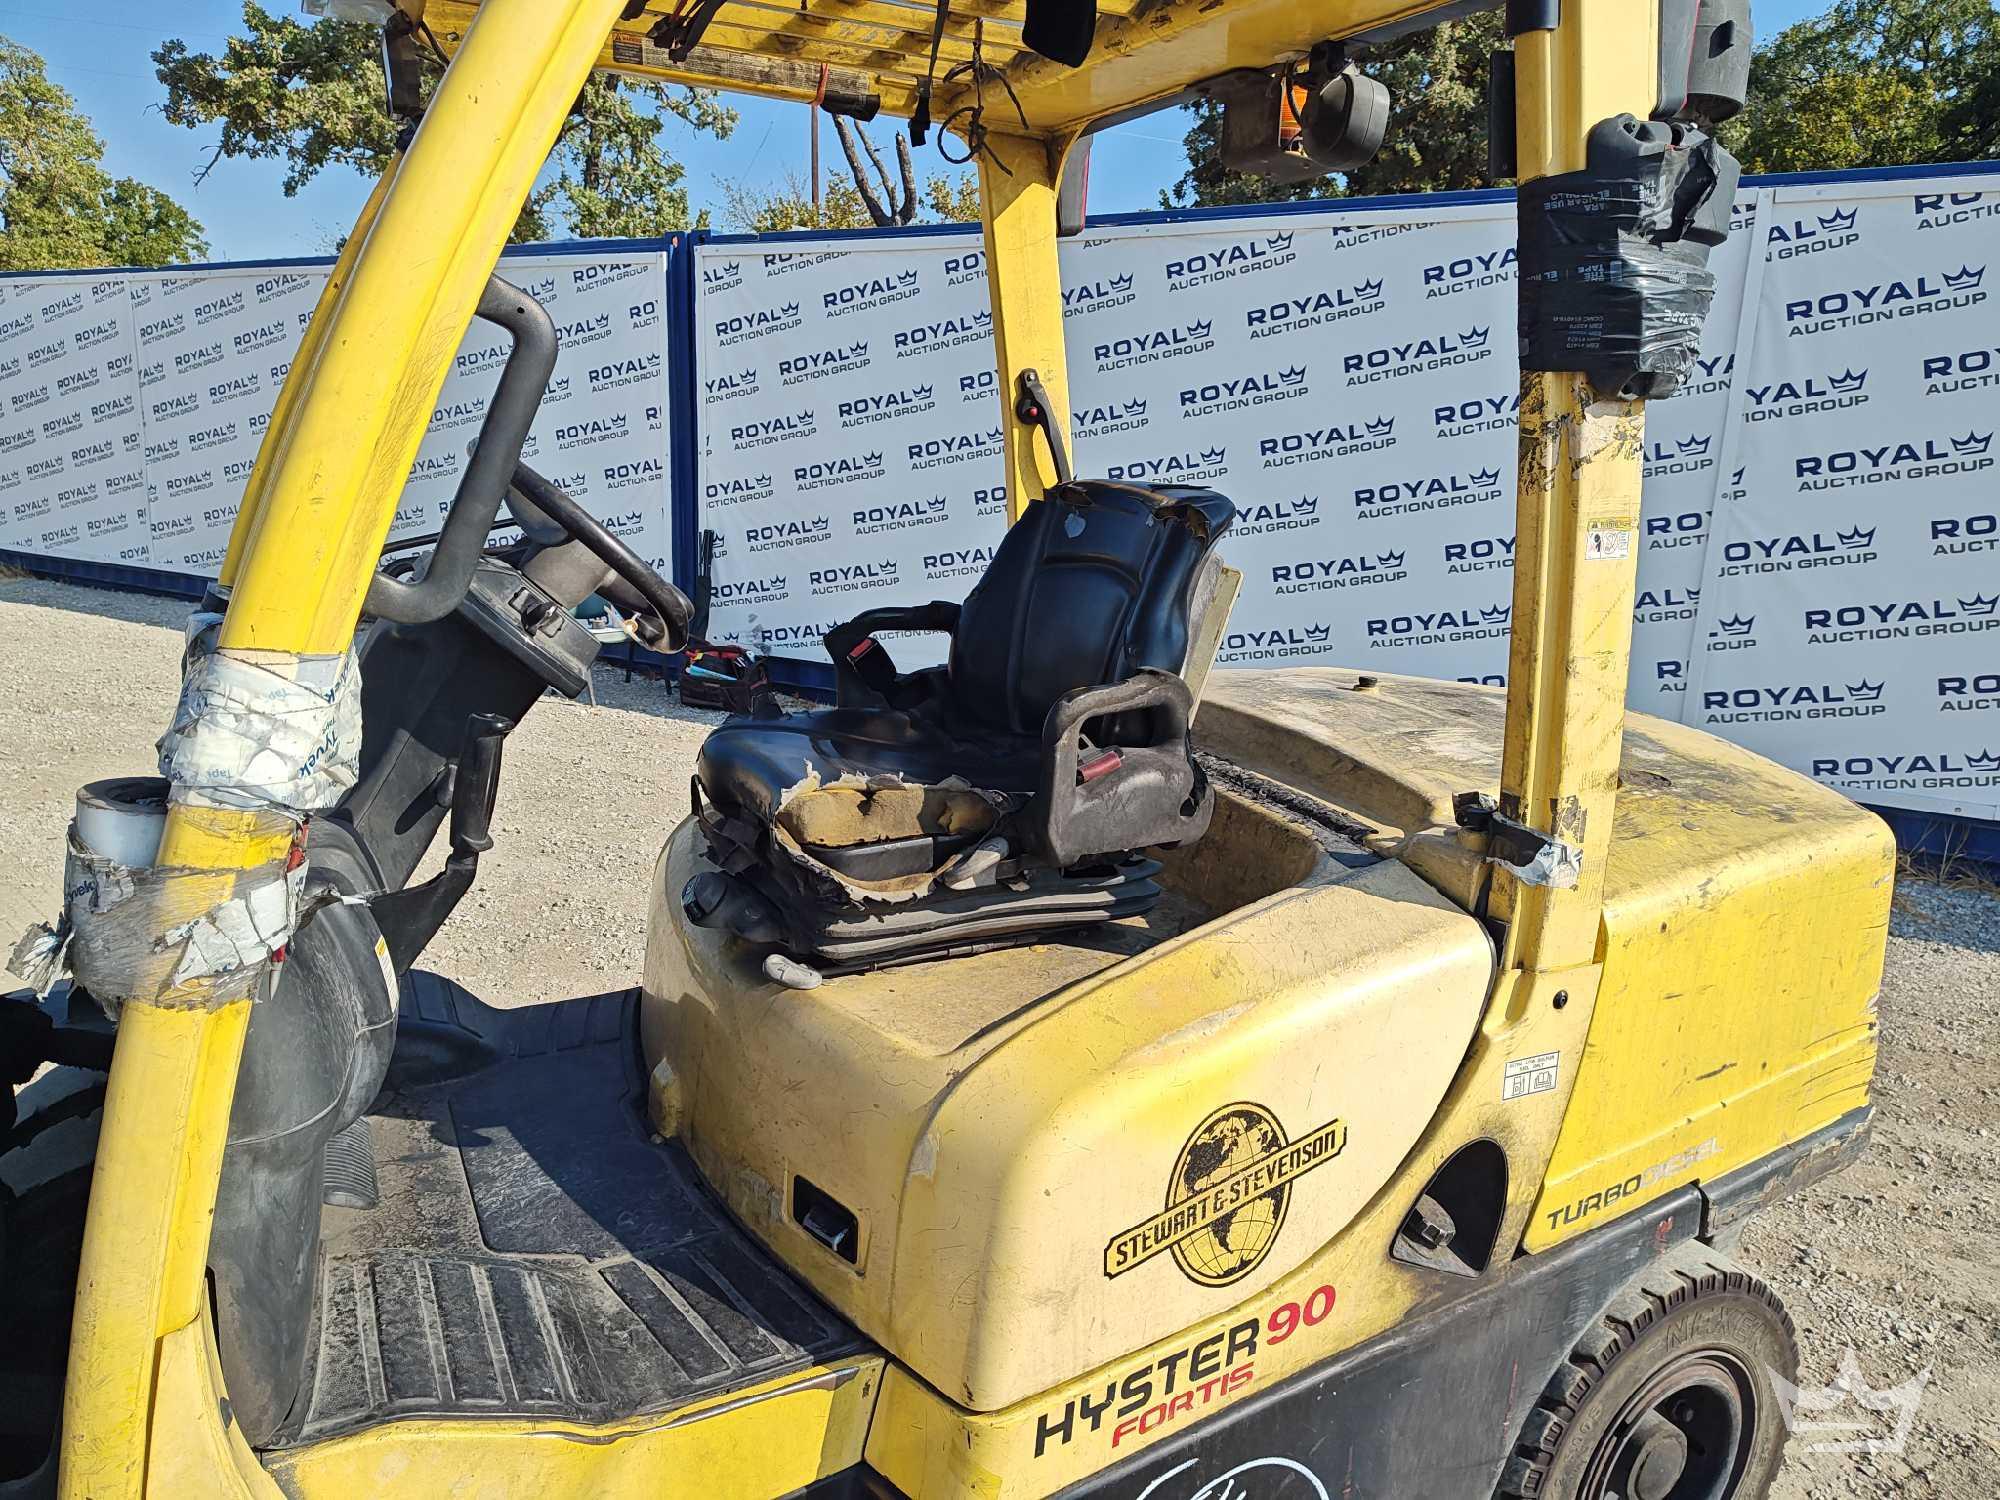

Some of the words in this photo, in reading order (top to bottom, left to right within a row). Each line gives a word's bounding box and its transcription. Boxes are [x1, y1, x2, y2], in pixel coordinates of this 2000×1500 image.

[1780, 233, 1859, 260] GROUP
[768, 259, 813, 277] AUCTION
[1166, 242, 1266, 279] ROYAL
[576, 276, 613, 293] AUCTION
[617, 266, 648, 281] GROUP
[1169, 268, 1235, 292] AUCTION
[1240, 252, 1295, 274] GROUP
[256, 274, 298, 295] ROYAL
[708, 279, 742, 294] GROUP
[823, 277, 897, 308] ROYAL
[1426, 271, 1508, 299] AUCTION
[42, 297, 73, 317] ROYAL
[194, 297, 233, 318] ROYAL
[827, 300, 876, 320] AUCTION
[879, 286, 919, 306] GROUP
[1087, 293, 1135, 314] GROUP
[1247, 289, 1354, 327] ROYAL
[1786, 277, 1941, 321] ROYAL
[715, 309, 782, 337] ROYAL
[1250, 316, 1320, 339] AUCTION
[1325, 300, 1384, 322] GROUP
[1789, 309, 1892, 338] AUCTION
[1899, 291, 1986, 318] GROUP
[75, 323, 109, 344] ROYAL
[139, 318, 174, 338] ROYAL
[234, 326, 274, 347] ROYAL
[582, 330, 612, 345] GROUP
[720, 329, 762, 347] AUCTION
[765, 317, 801, 334] GROUP
[894, 317, 973, 348] ROYAL
[28, 344, 58, 362] ROYAL
[897, 340, 948, 360] AUCTION
[1094, 328, 1187, 361] ROYAL
[1098, 352, 1158, 372] AUCTION
[1162, 339, 1213, 359] GROUP
[1344, 336, 1458, 374] ROYAL
[175, 347, 212, 367] ROYAL
[456, 345, 508, 368] ROYAL
[779, 348, 850, 376] ROYAL
[1347, 363, 1422, 387] AUCTION
[1427, 348, 1490, 370] GROUP
[57, 371, 89, 390] ROYAL
[459, 363, 493, 377] AUCTION
[588, 358, 647, 383] ROYAL
[782, 369, 828, 386] AUCTION
[831, 357, 869, 374] GROUP
[209, 378, 248, 397] ROYAL
[592, 377, 630, 393] AUCTION
[726, 386, 759, 399] GROUP
[1180, 374, 1278, 406] ROYAL
[11, 388, 41, 406] ROYAL
[91, 398, 125, 417] ROYAL
[153, 396, 189, 415] ROYAL
[838, 391, 913, 418] ROYAL
[1183, 398, 1248, 418] AUCTION
[1253, 386, 1307, 405] GROUP
[1789, 395, 1869, 416] GROUP
[43, 416, 73, 433] ROYAL
[842, 411, 891, 428] AUCTION
[894, 400, 934, 417] GROUP
[189, 426, 227, 444] ROYAL
[555, 419, 612, 441] ROYAL
[731, 416, 798, 440] ROYAL
[1102, 417, 1148, 435] GROUP
[1437, 416, 1519, 438] AUCTION
[559, 437, 596, 449] AUCTION
[598, 429, 628, 441] GROUP
[734, 436, 778, 450] AUCTION
[780, 427, 816, 441] GROUP
[908, 433, 986, 460] ROYAL
[1260, 425, 1365, 456] ROYAL
[72, 444, 104, 461] ROYAL
[912, 454, 963, 470] AUCTION
[1263, 448, 1332, 468] AUCTION
[1337, 436, 1395, 456] GROUP
[1796, 440, 1949, 478] ROYAL
[26, 459, 56, 475] ROYAL
[604, 458, 663, 480] ROYAL
[794, 457, 864, 481] ROYAL
[1108, 454, 1200, 479] ROYAL
[1177, 467, 1228, 482] GROUP
[1643, 459, 1713, 478] GROUP
[1798, 470, 1900, 494] AUCTION
[1907, 457, 1993, 479] GROUP
[167, 474, 202, 490] ROYAL
[608, 476, 646, 489] AUCTION
[797, 477, 843, 490] AUCTION
[846, 468, 884, 482] GROUP
[58, 487, 88, 502] ROYAL
[740, 490, 773, 504] GROUP
[1354, 476, 1469, 507] ROYAL
[14, 498, 43, 515] ROYAL
[853, 501, 927, 525] ROYAL
[1358, 500, 1432, 520] AUCTION
[1438, 488, 1501, 508] GROUP
[42, 525, 72, 542] ROYAL
[746, 521, 812, 543] ROYAL
[856, 521, 904, 535] AUCTION
[908, 513, 948, 527] GROUP
[1266, 518, 1320, 535] GROUP
[750, 539, 792, 552] AUCTION
[795, 532, 830, 545] GROUP
[1272, 556, 1377, 582] ROYAL
[1798, 552, 1877, 569] GROUP
[809, 564, 879, 585] ROYAL
[926, 566, 978, 580] AUCTION
[1276, 578, 1345, 594] AUCTION
[1350, 570, 1406, 586] GROUP
[710, 580, 770, 598] ROYAL
[812, 582, 858, 595] AUCTION
[860, 576, 898, 588] GROUP
[710, 598, 752, 608] AUCTION
[754, 592, 788, 603] GROUP
[1367, 610, 1479, 636] ROYAL
[1805, 600, 1956, 629] ROYAL
[762, 624, 826, 642] ROYAL
[1370, 633, 1444, 649] AUCTION
[1450, 627, 1511, 641] GROUP
[1808, 627, 1908, 644] AUCTION
[1916, 620, 2000, 636] GROUP
[1278, 644, 1333, 657] GROUP
[1704, 685, 1845, 710] ROYAL
[1706, 709, 1800, 724] AUCTION
[1807, 704, 1884, 718] GROUP
[299, 728, 338, 779] Tyvek
[1813, 755, 1963, 777] ROYAL
[1116, 1198, 1207, 1267] STEWART
[1230, 1129, 1336, 1205] STEVENSON
[1034, 1317, 1260, 1459] HYSTER
[1267, 1284, 1336, 1345] 90
[1112, 1362, 1254, 1448] FORTIS
